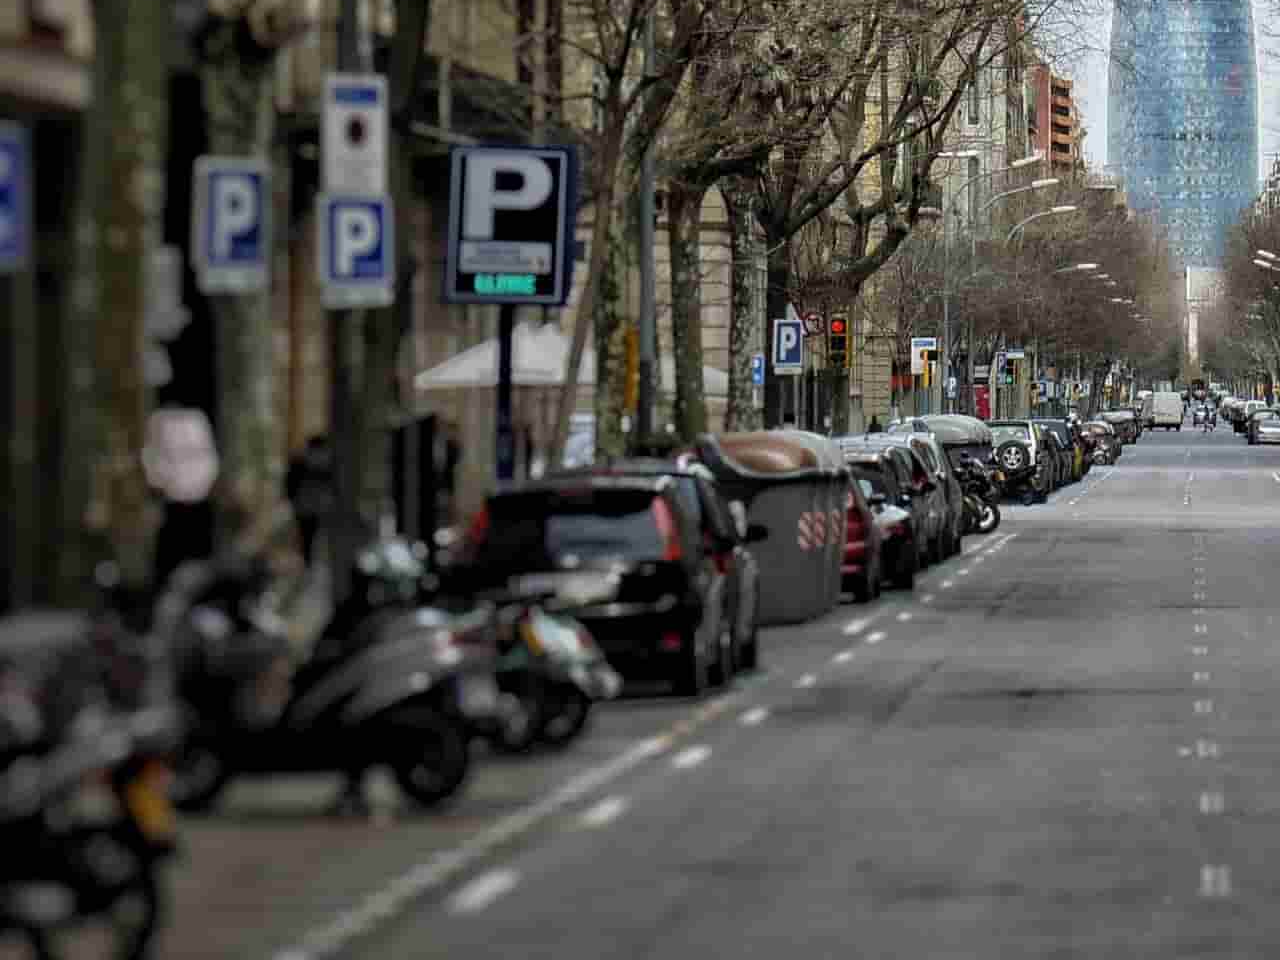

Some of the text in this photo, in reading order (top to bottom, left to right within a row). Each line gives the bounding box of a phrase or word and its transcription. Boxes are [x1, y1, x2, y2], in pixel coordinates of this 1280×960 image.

[212, 176, 256, 259] P
[463, 153, 552, 240] P
[337, 208, 379, 276] P
[780, 326, 797, 360] P
